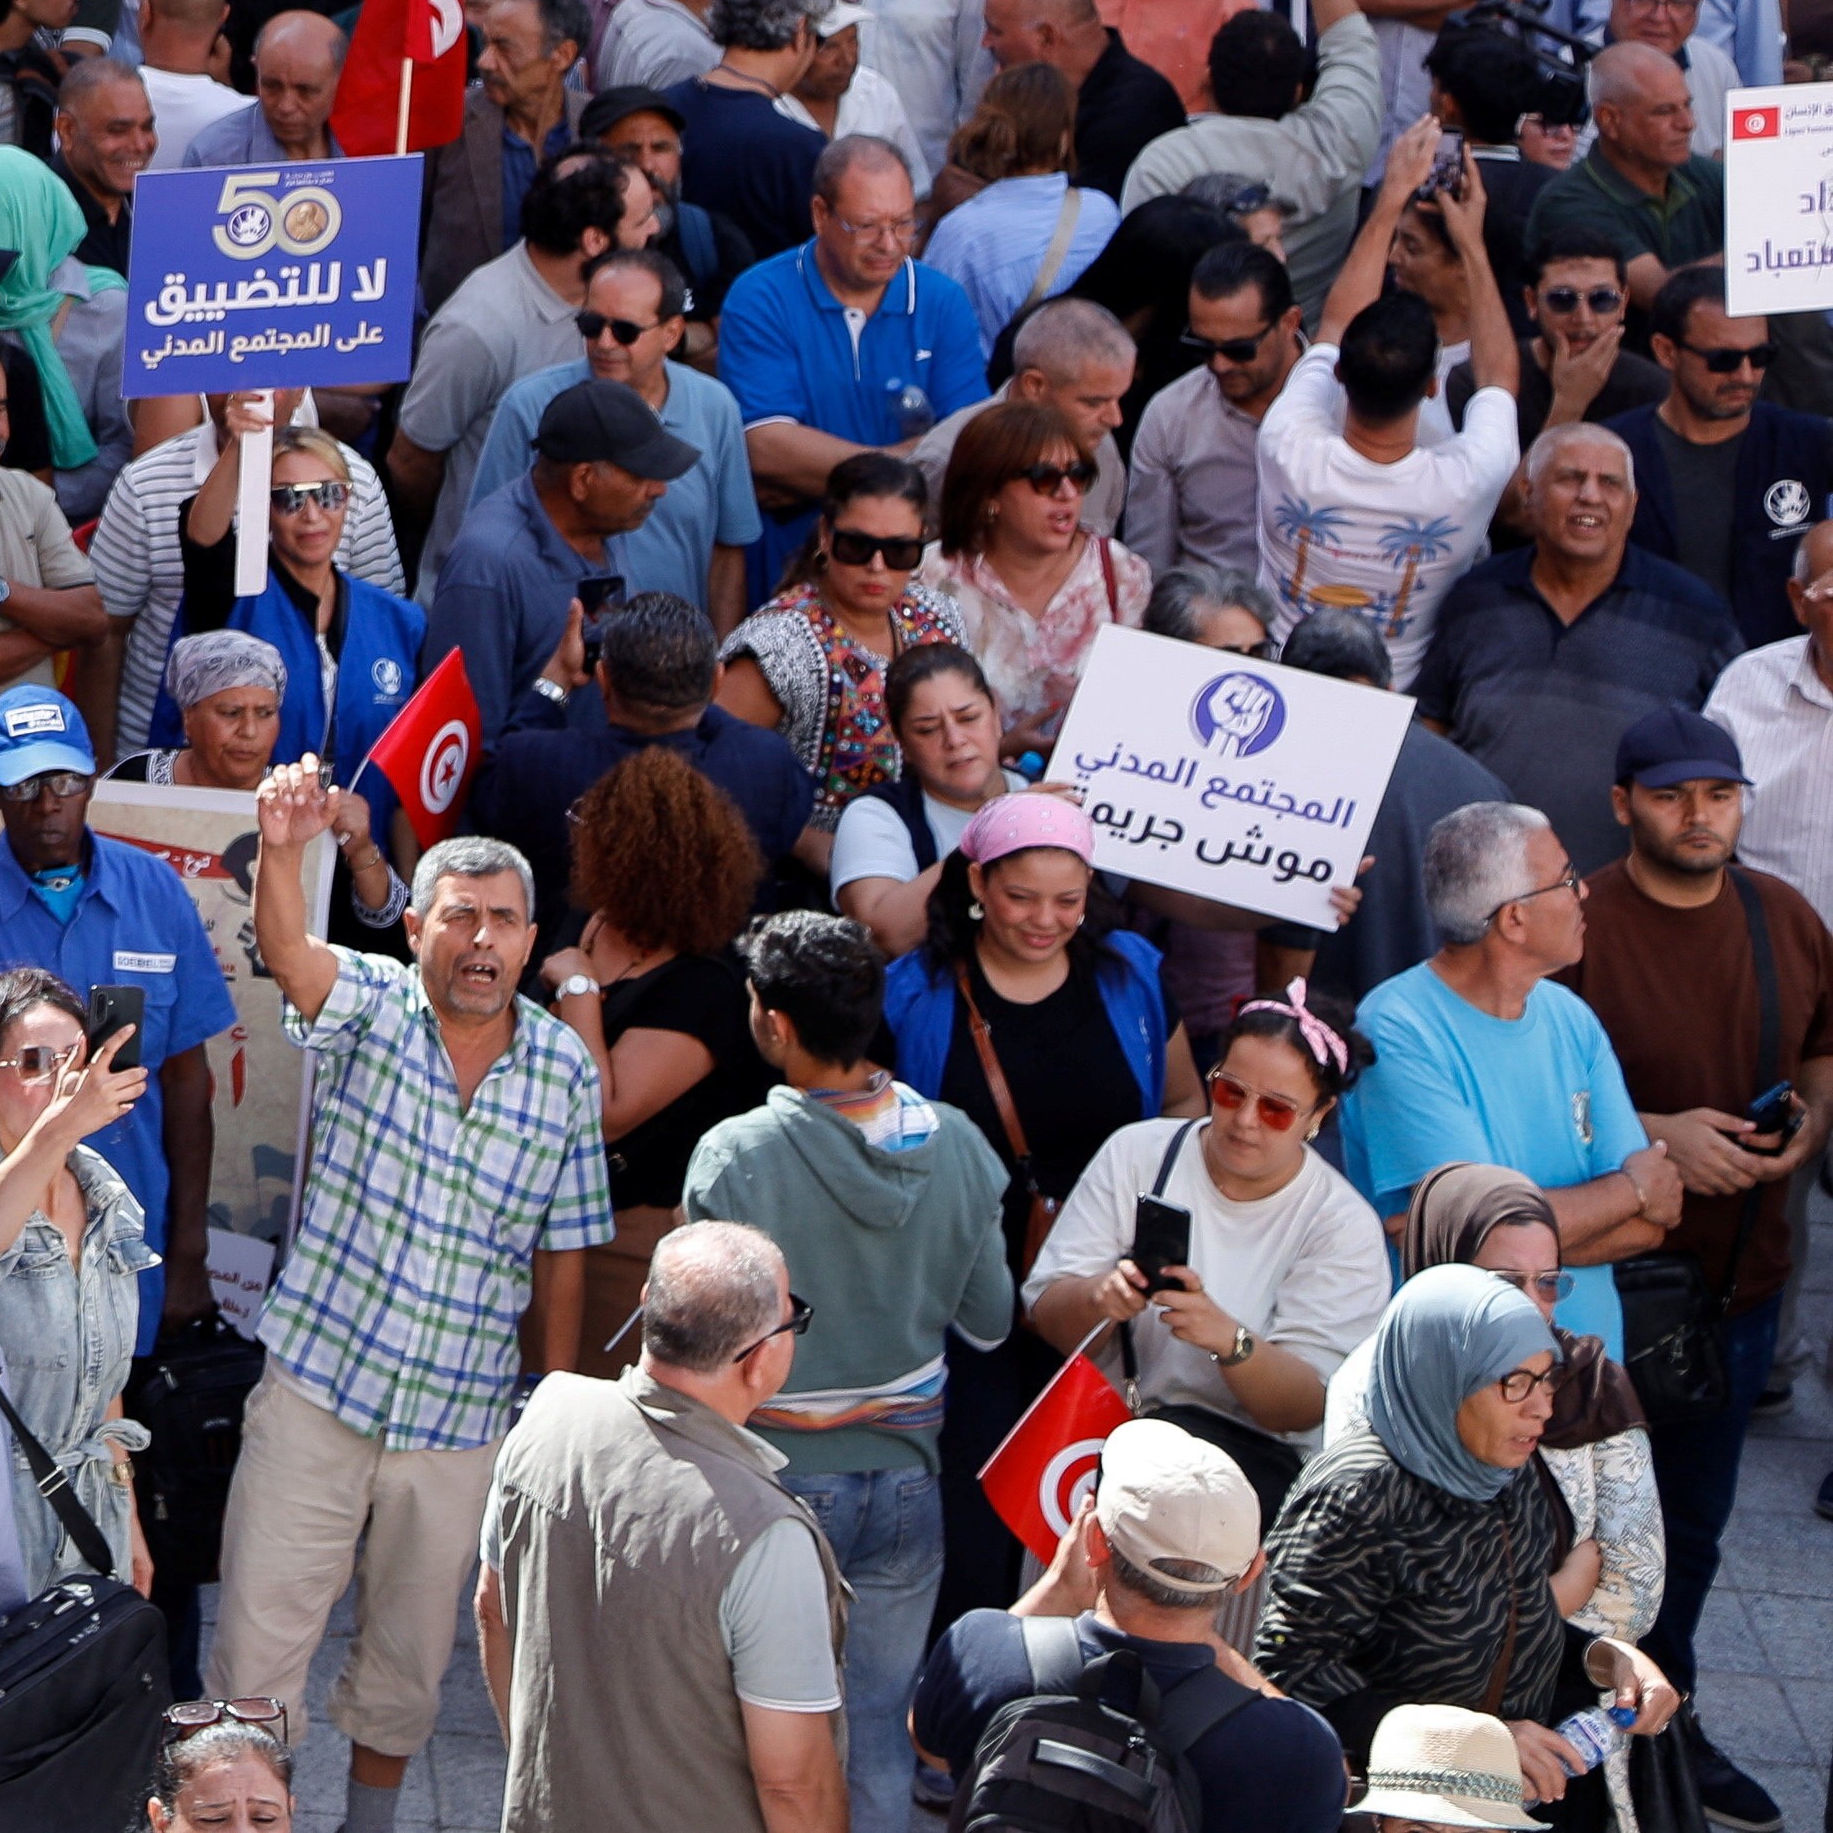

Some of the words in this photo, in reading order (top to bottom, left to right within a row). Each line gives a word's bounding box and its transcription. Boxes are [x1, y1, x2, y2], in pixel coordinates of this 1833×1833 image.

[211, 171, 343, 261] 50
[145, 261, 341, 326] للتضييق
[351, 258, 387, 302] لا
[141, 330, 225, 369] المدني
[229, 323, 331, 363] المجتمع
[335, 321, 384, 352] على
[1075, 743, 1198, 788] المدني
[1200, 777, 1356, 829] المجتمع
[1195, 825, 1333, 883] موش
